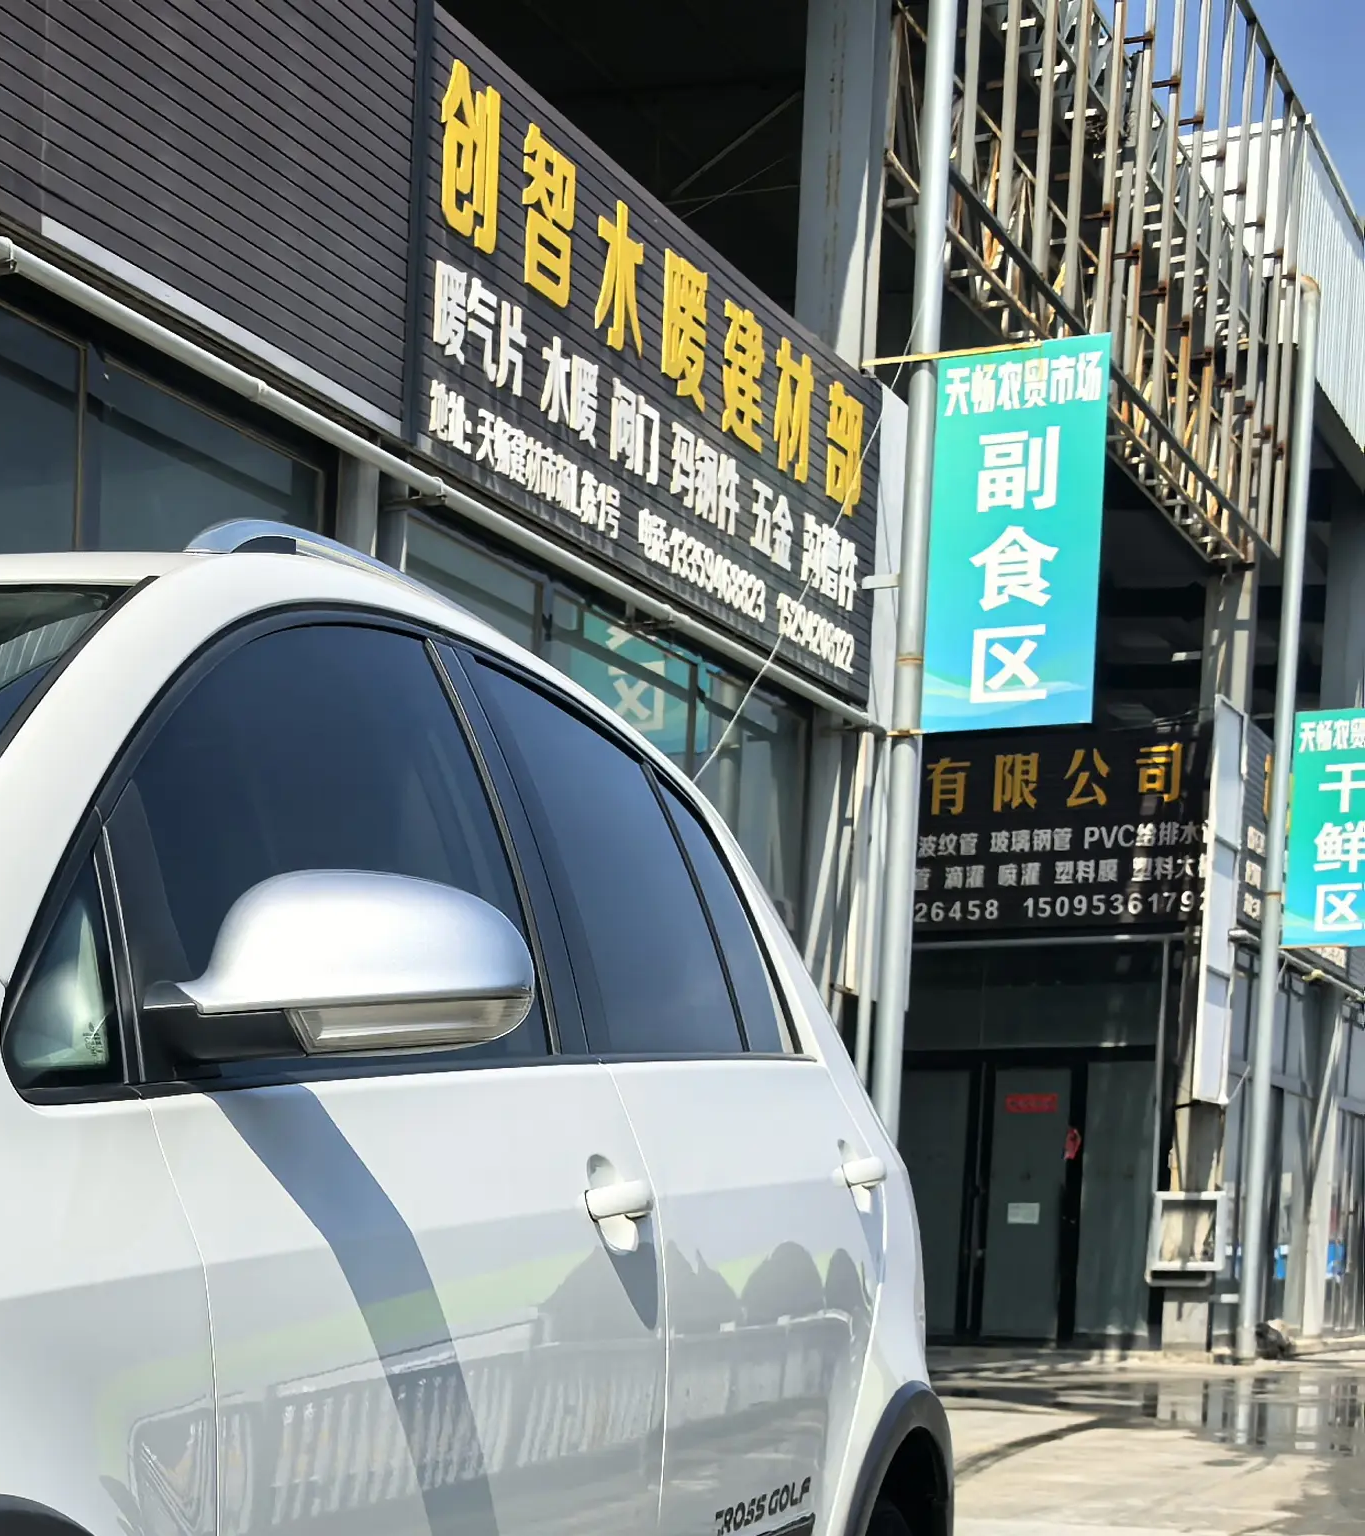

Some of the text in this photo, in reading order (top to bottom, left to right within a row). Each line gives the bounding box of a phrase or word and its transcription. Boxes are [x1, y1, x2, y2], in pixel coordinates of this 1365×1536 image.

[441, 59, 864, 517] 创智水暖建材部
[433, 260, 528, 397] 暖气片
[540, 336, 599, 449] 水暖
[750, 478, 794, 572] 五金
[944, 351, 1103, 417] 天畅农贸市场
[970, 425, 1061, 704] 副食区
[926, 742, 1184, 815] 有限公司
[989, 828, 1073, 854] 玻璃钢管
[1054, 858, 1120, 885] 塑料膜
[914, 890, 1205, 923] 26458 1509536179
[768, 1476, 811, 1516] GOLF
